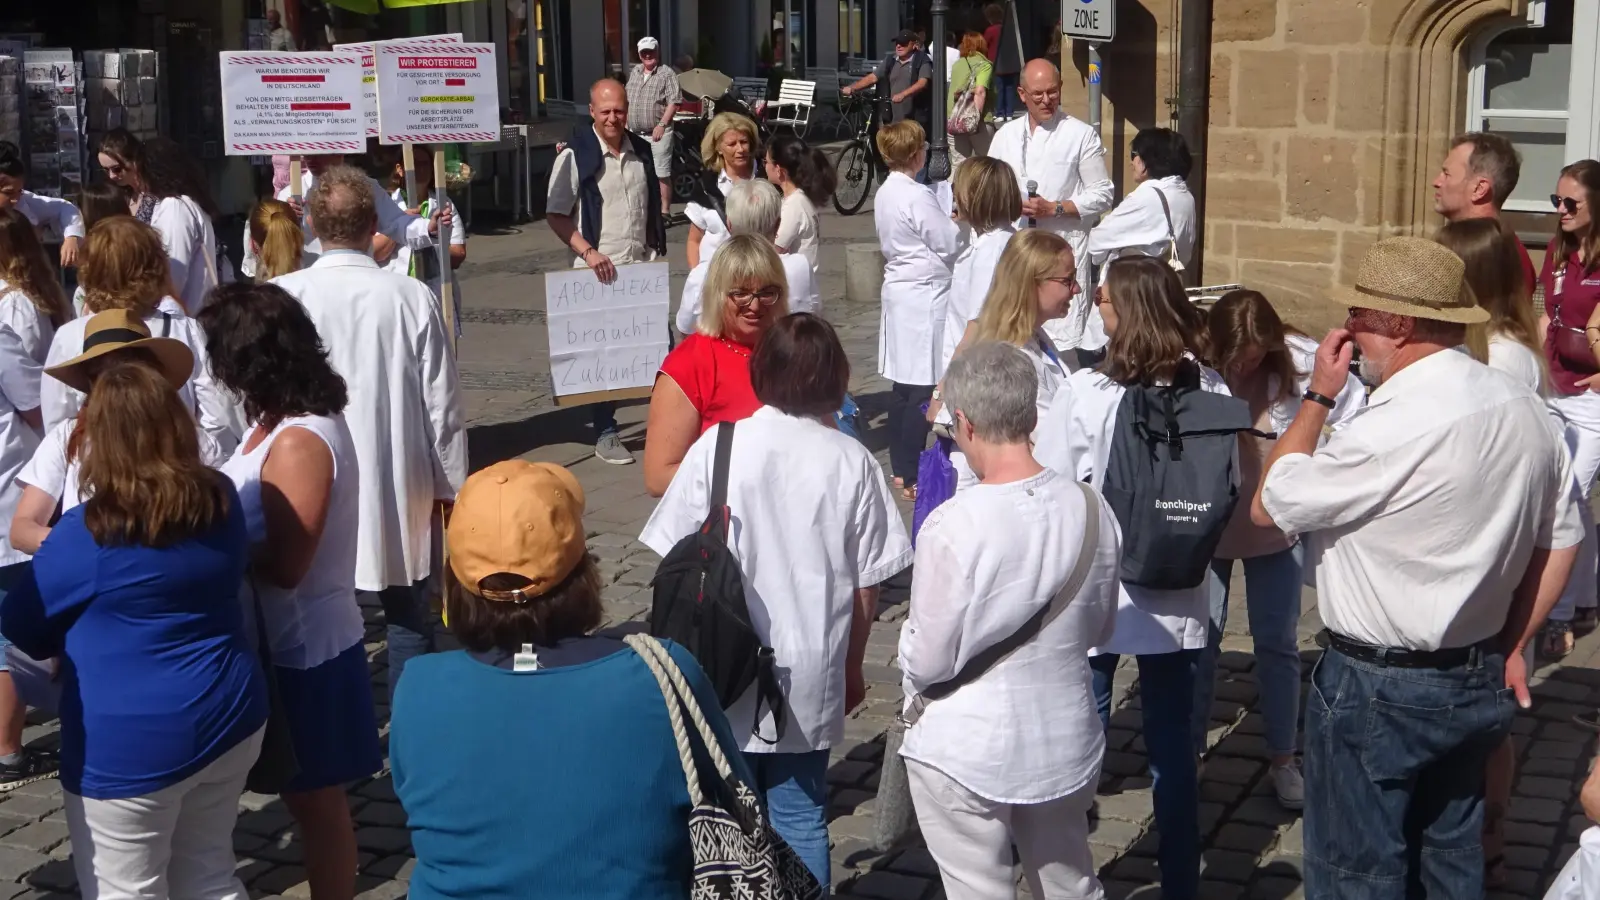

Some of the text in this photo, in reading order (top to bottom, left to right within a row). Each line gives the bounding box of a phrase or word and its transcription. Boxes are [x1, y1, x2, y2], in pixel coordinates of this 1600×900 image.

[1074, 9, 1099, 29] ZONE
[400, 58, 475, 67] WIR PROTESTIEREN
[566, 314, 658, 345] braucht
